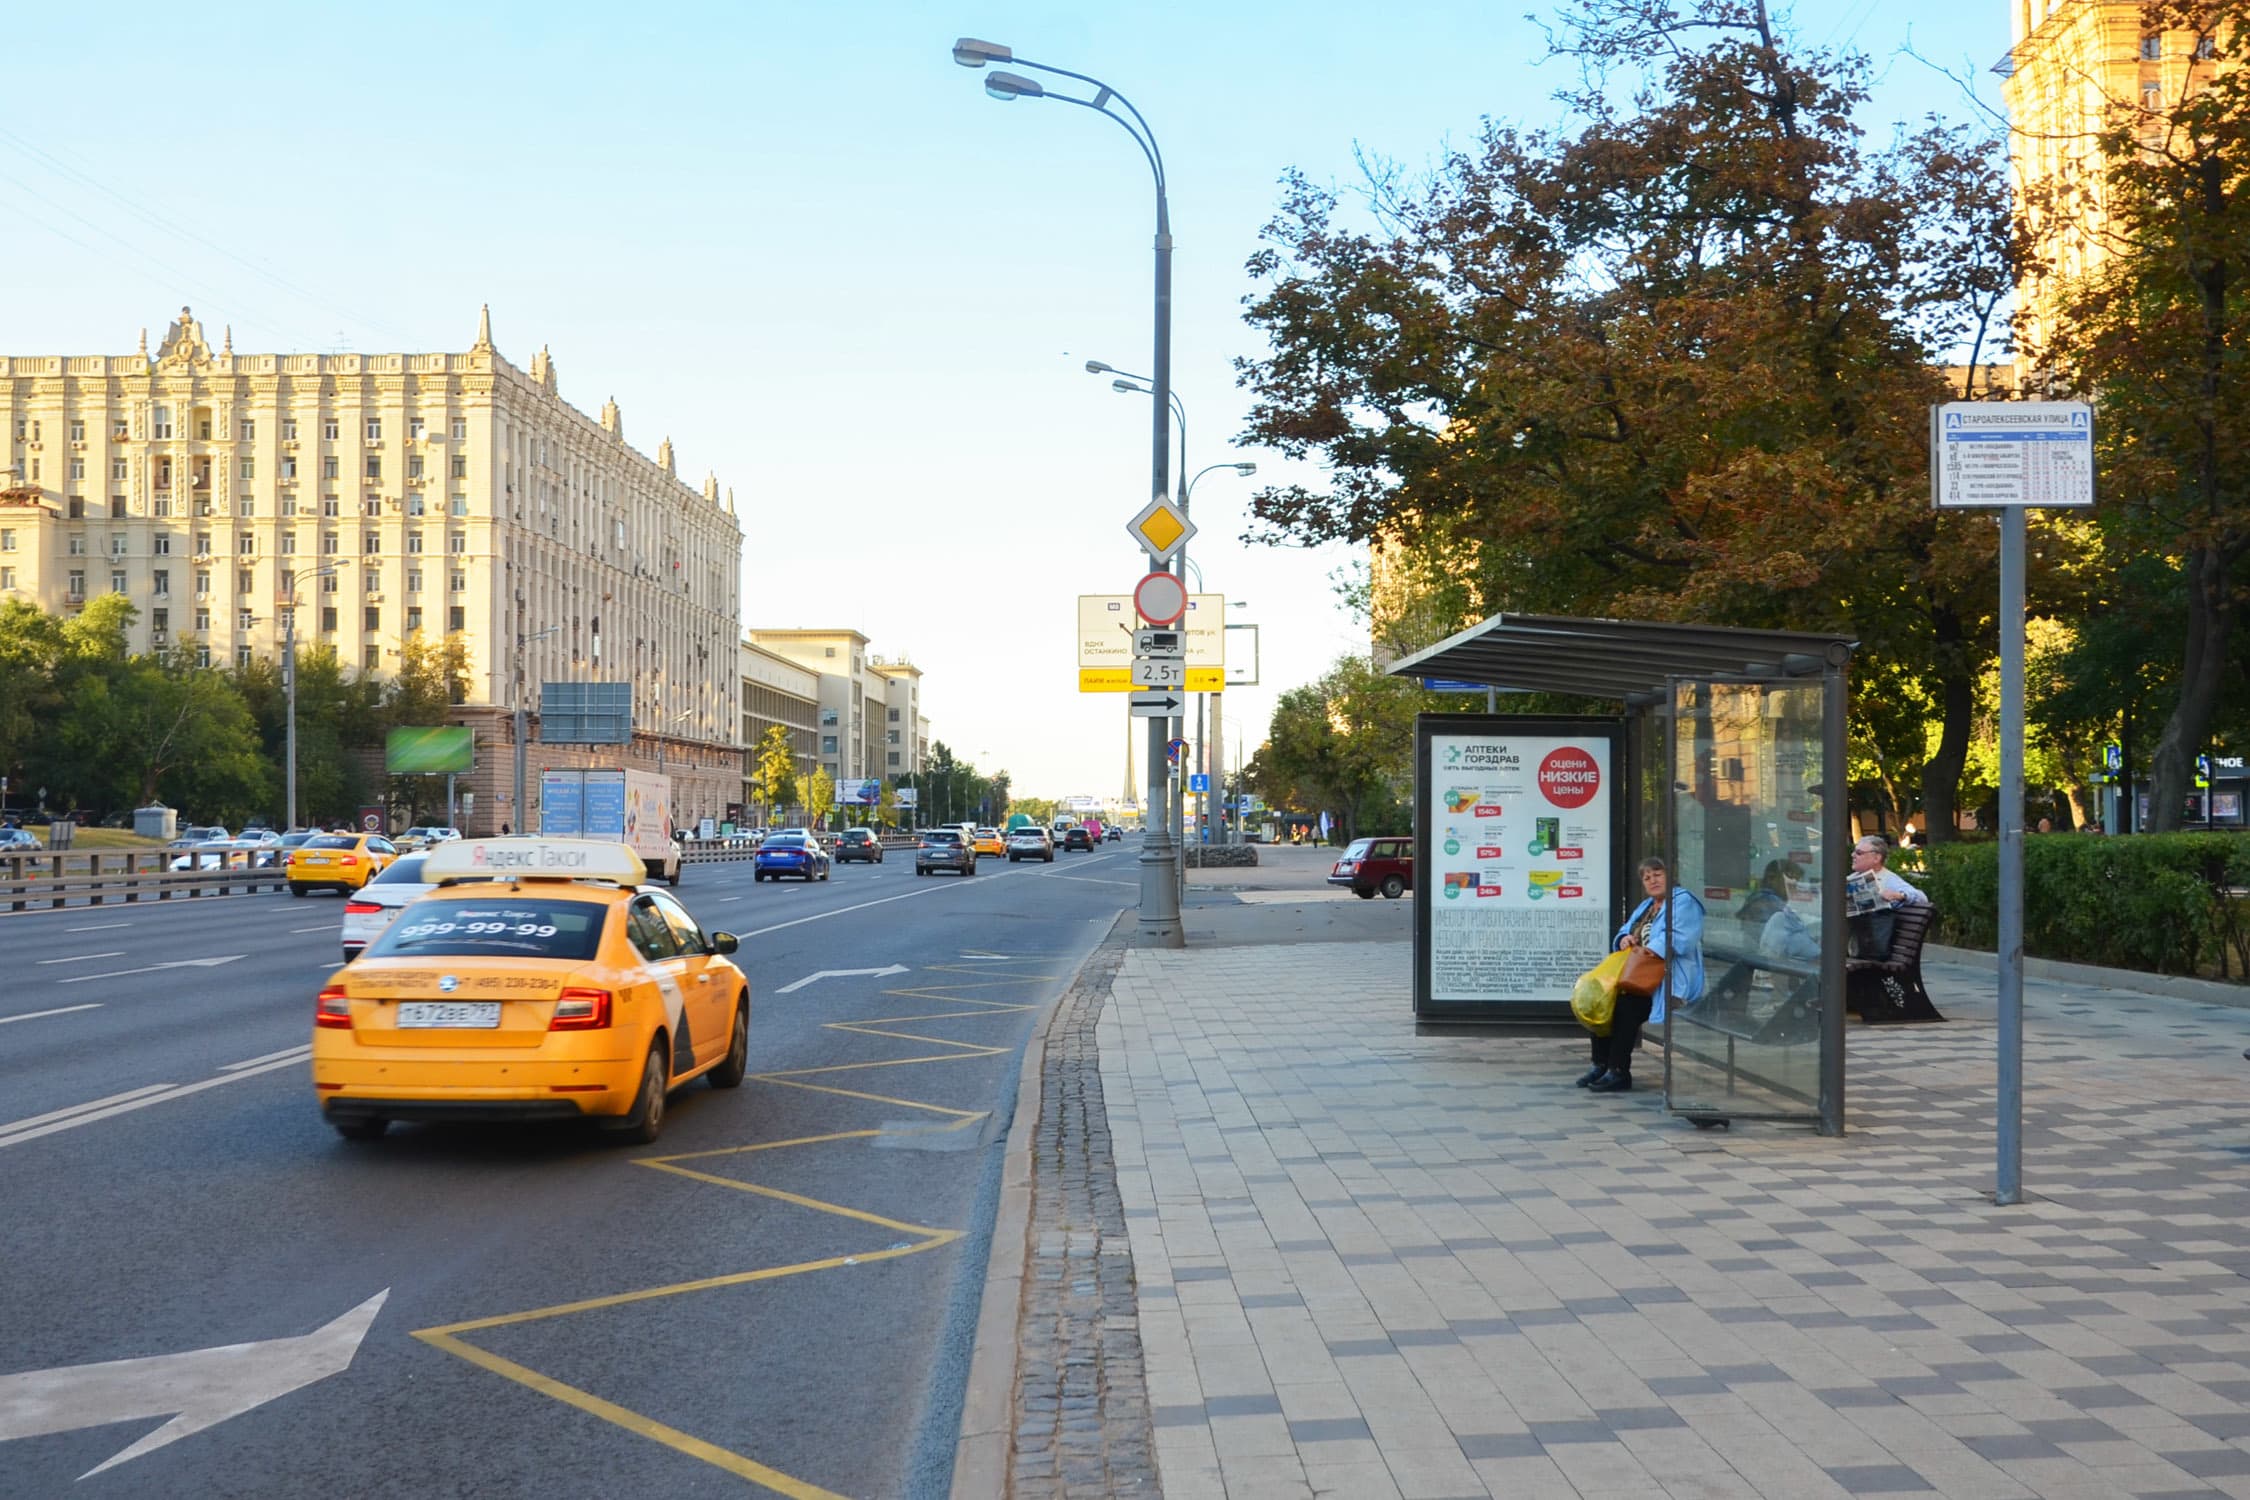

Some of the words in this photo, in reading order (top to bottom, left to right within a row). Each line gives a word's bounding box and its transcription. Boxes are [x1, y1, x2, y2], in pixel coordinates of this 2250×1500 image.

[1963, 414, 2042, 425] СТАРОАЛЕКСЕЕВСКАЯ
[2043, 413, 2069, 424] УЛИЦА
[1464, 745, 1507, 754] АПТЕКИ
[1464, 755, 1520, 764] ГОРЗДРАВ
[1550, 759, 1587, 769] оцени
[1540, 771, 1597, 783] НИЗКИЕ
[1553, 786, 1584, 795] цены
[472, 845, 534, 869] Яндекс
[538, 845, 586, 867] Такси
[398, 921, 558, 938] 999-99-99
